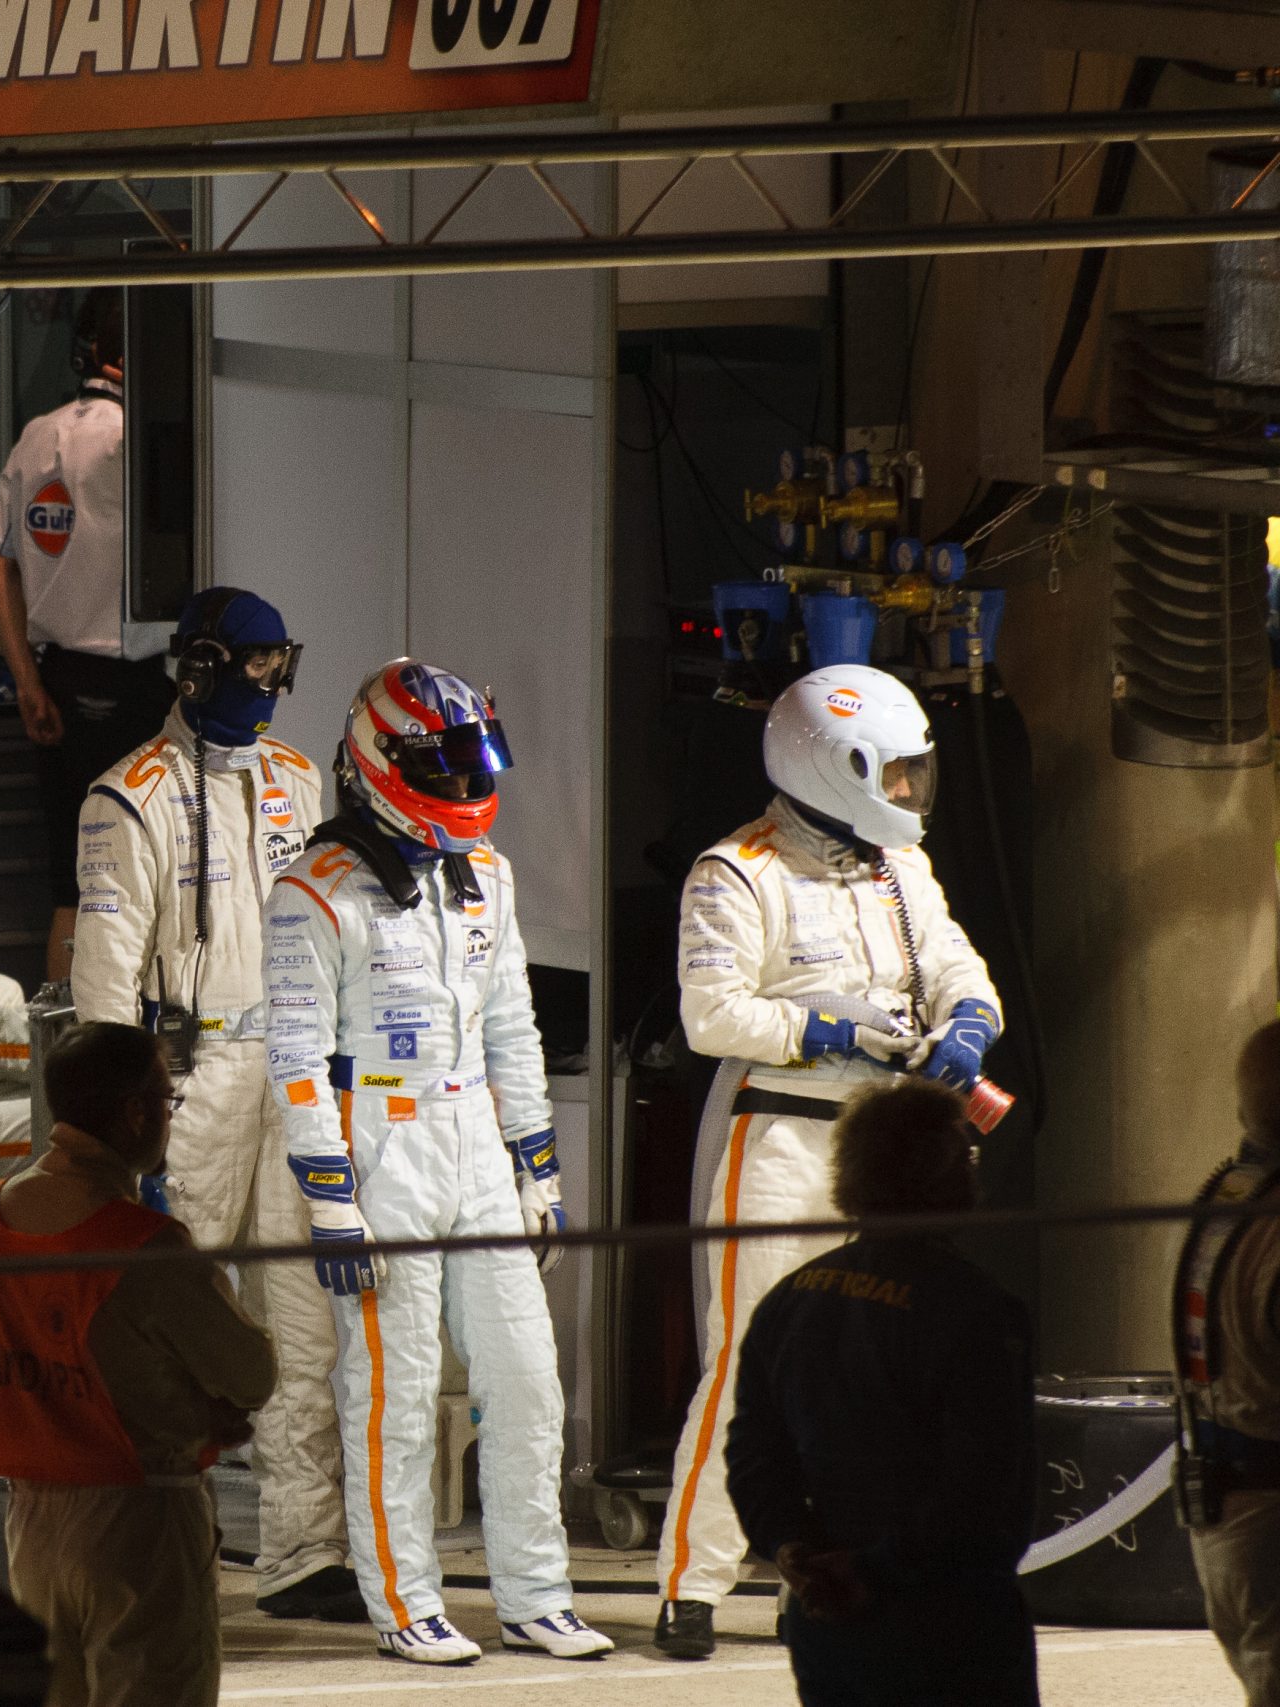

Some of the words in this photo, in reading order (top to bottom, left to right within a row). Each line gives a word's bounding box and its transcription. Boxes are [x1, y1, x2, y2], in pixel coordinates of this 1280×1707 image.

[29, 506, 74, 531] Gulf
[827, 693, 863, 711] Gulf
[802, 951, 844, 963] MICHELIN
[384, 961, 423, 971] MICHELIN
[363, 1075, 402, 1088] Sabelt
